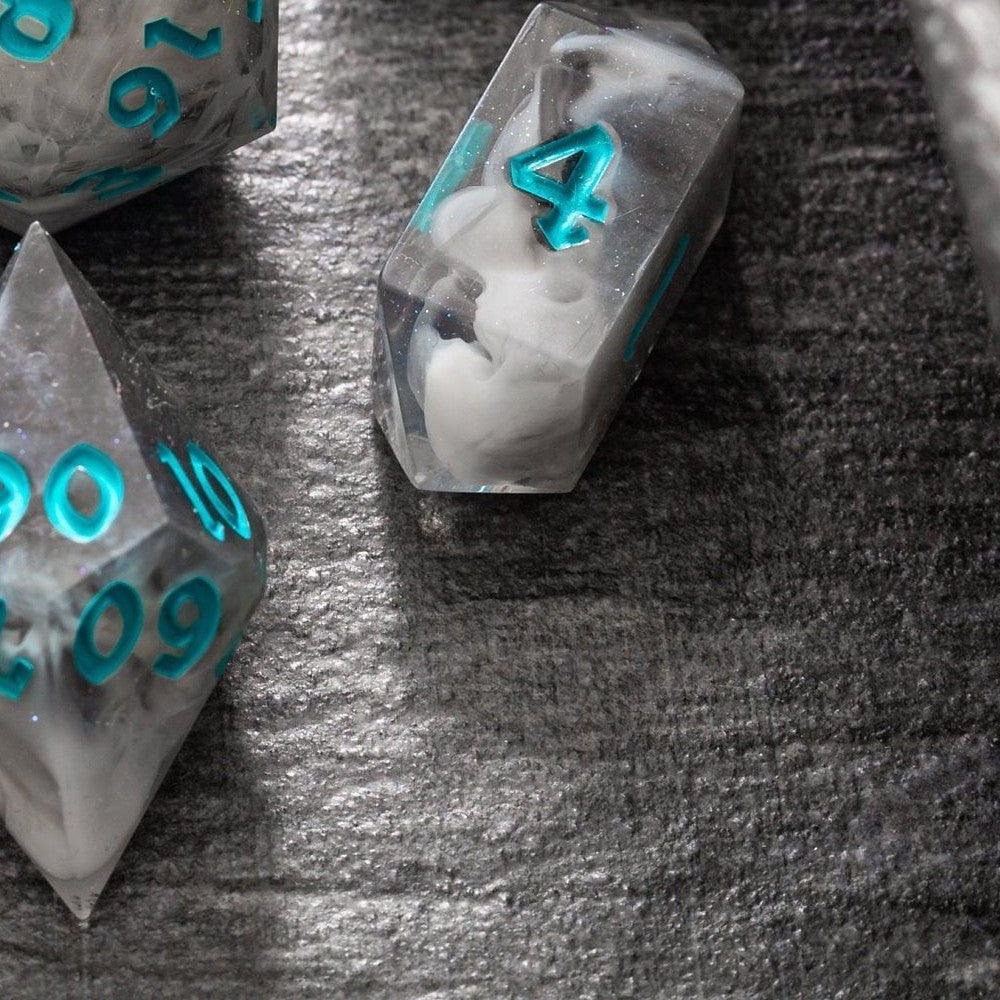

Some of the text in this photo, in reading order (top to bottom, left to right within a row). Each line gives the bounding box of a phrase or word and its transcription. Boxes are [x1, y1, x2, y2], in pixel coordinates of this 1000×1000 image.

[107, 17, 223, 140] 16
[508, 121, 616, 252] 4
[155, 439, 253, 543] 10
